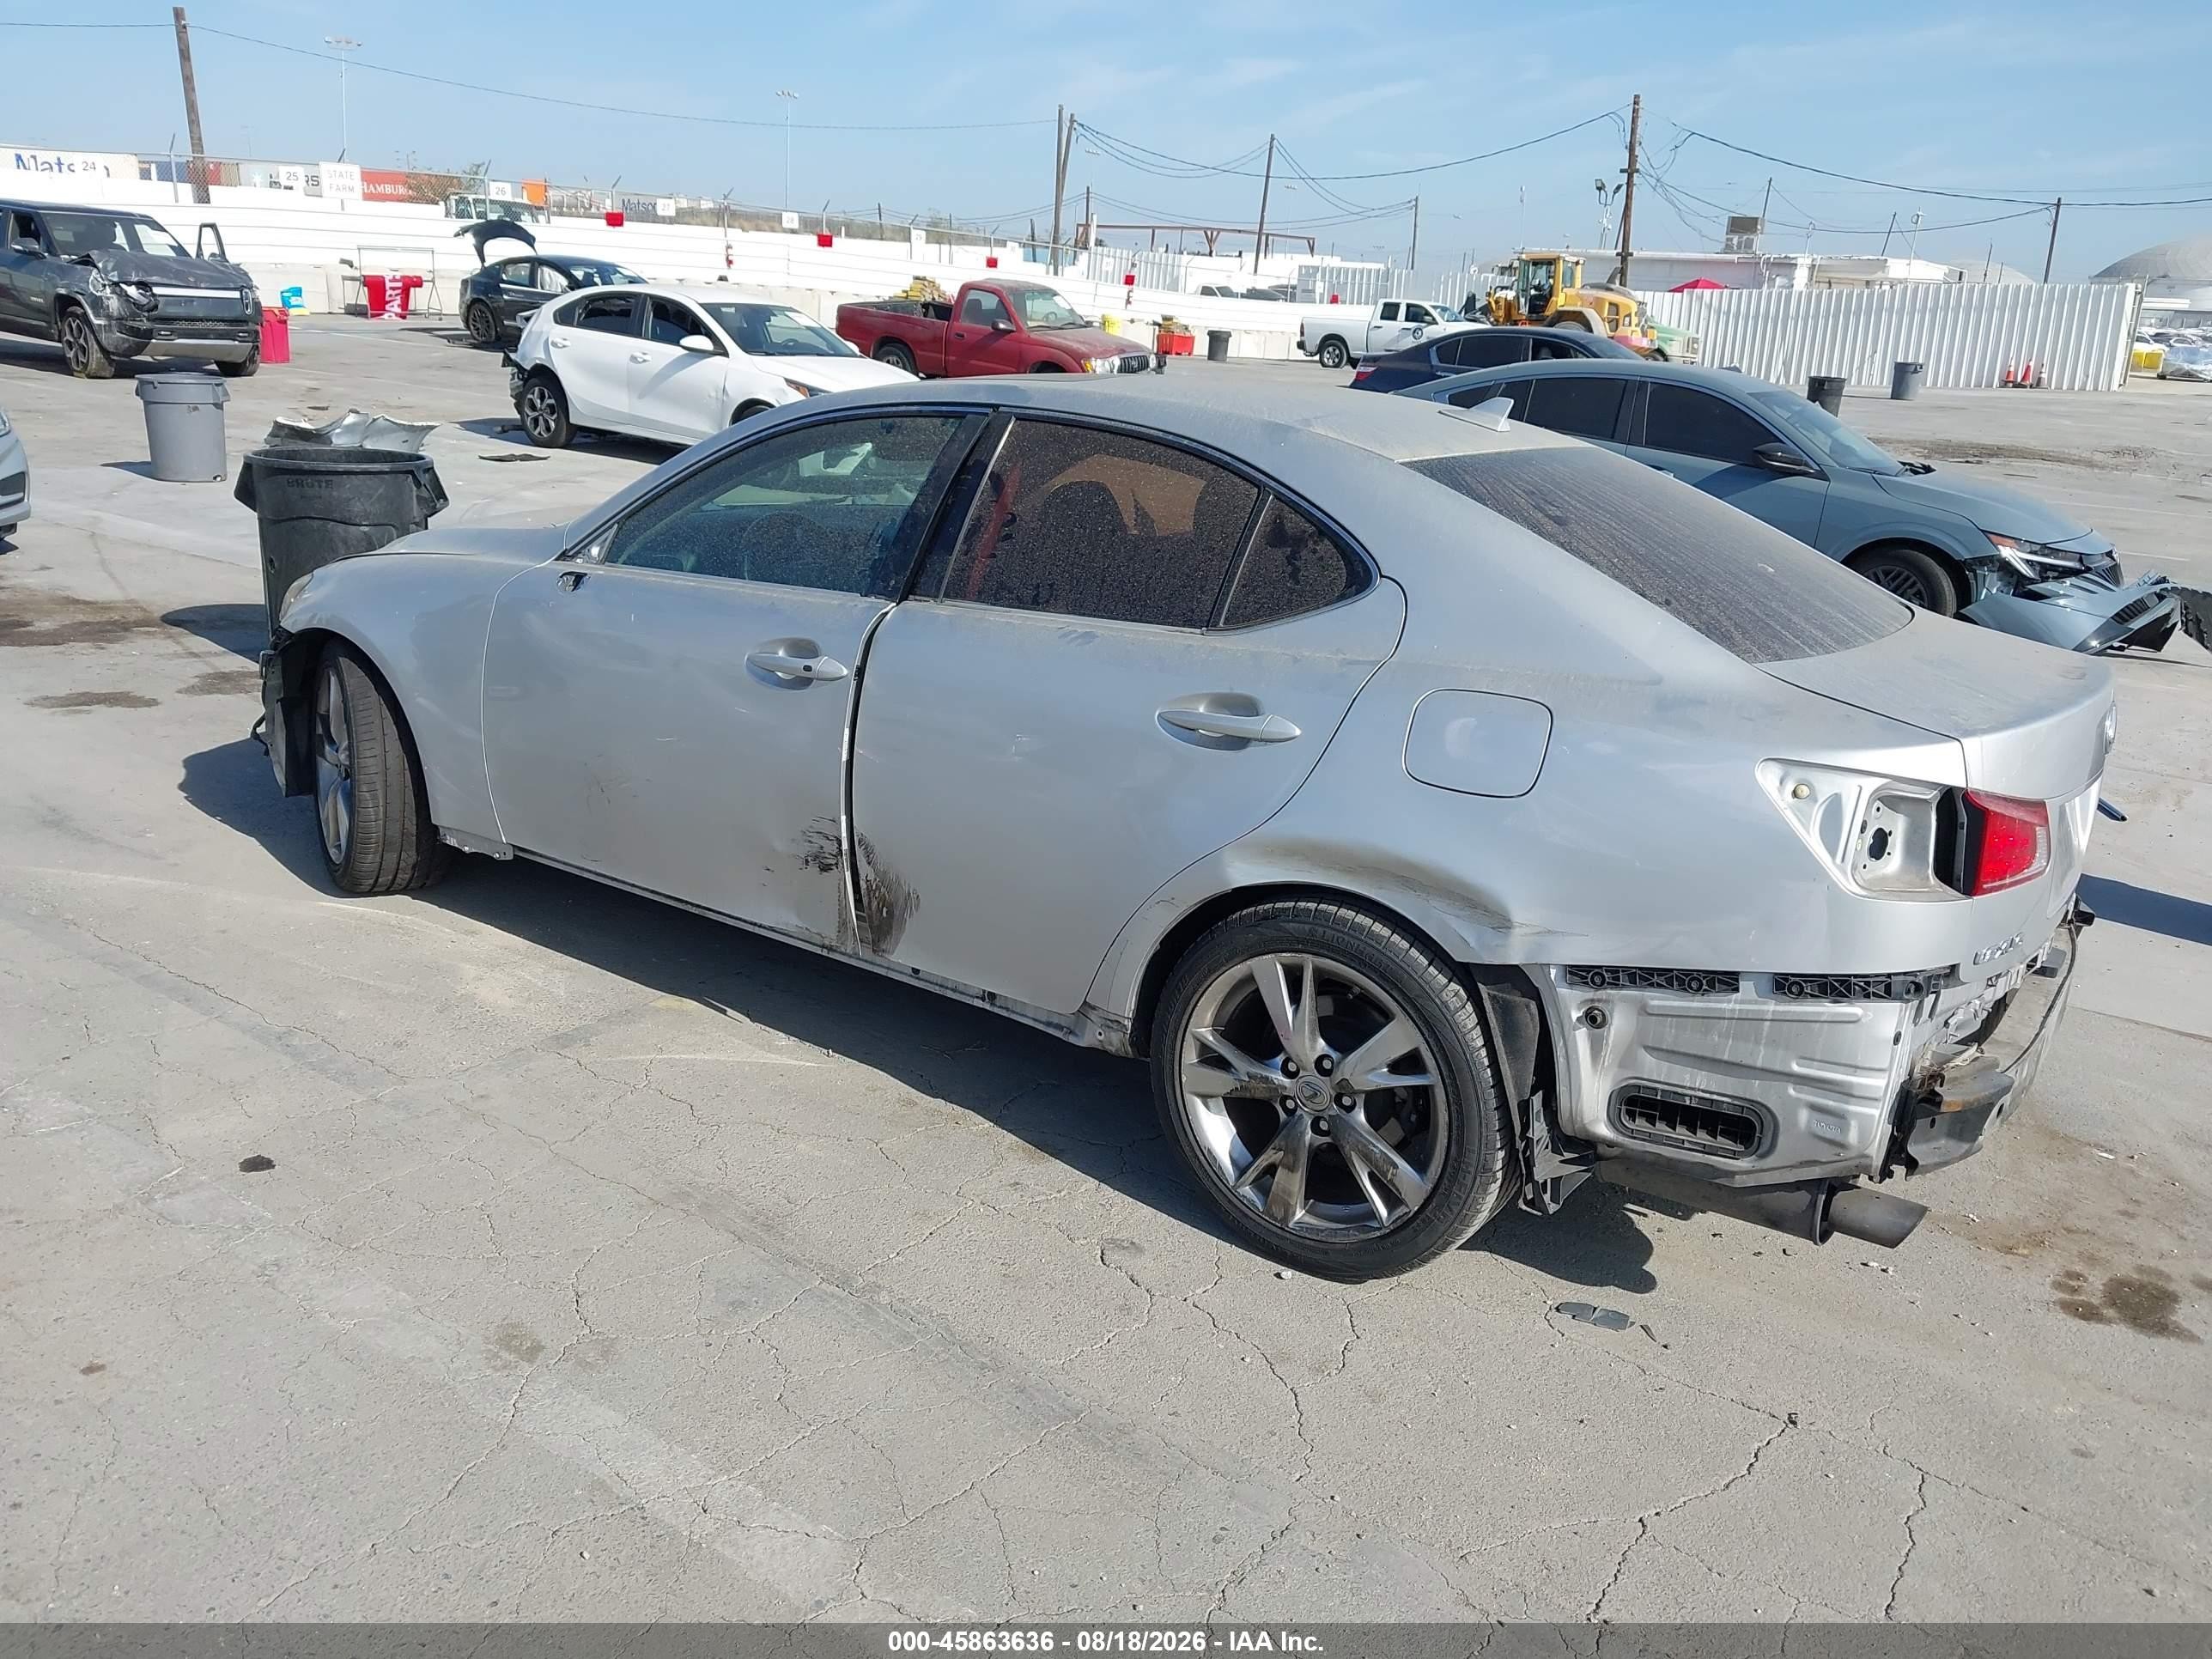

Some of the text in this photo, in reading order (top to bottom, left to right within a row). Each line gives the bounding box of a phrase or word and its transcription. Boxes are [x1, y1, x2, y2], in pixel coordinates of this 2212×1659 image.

[82, 161, 96, 171] 24
[286, 171, 299, 181] 25
[327, 169, 356, 180] STATE
[329, 183, 356, 193] FARM
[495, 186, 507, 197] 26
[286, 478, 334, 489] BRUTE
[1814, 1119, 1842, 1134] TOYOTA
